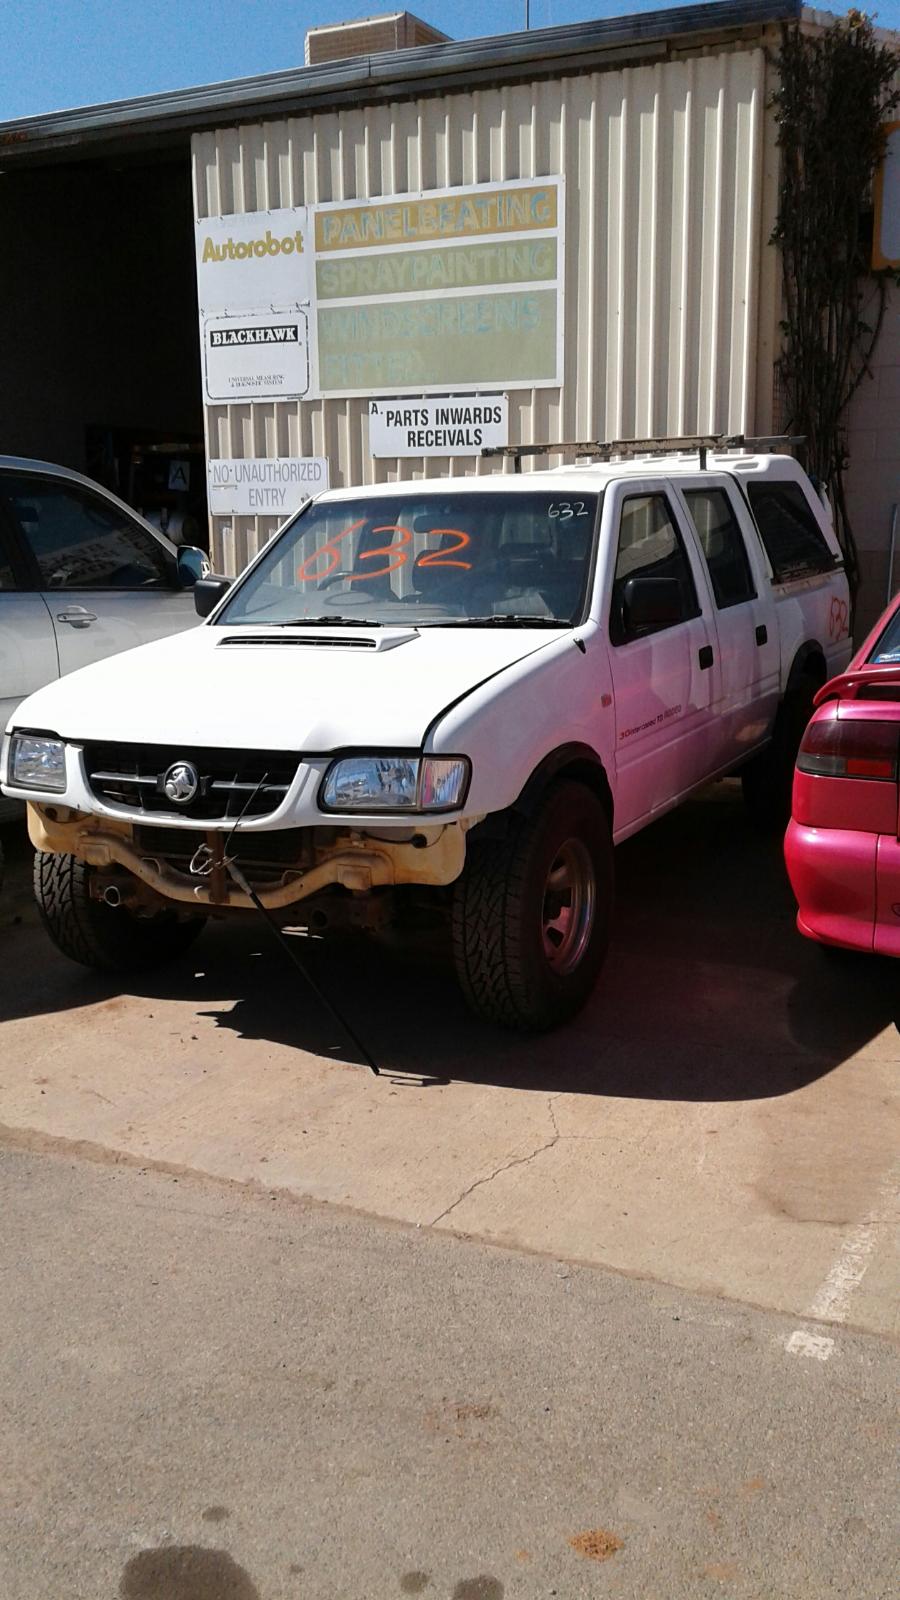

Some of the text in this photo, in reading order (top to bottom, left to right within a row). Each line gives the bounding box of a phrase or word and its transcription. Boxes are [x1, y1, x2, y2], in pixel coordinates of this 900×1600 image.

[322, 190, 551, 245] PANELBEATING
[202, 230, 304, 263] Autorobot
[320, 242, 551, 293] SPRAYPAINTING
[211, 327, 297, 346] BLACKHAWK
[386, 406, 502, 427] PARTS INWARDS
[407, 428, 482, 448] RECEIVALS
[172, 465, 187, 485] A
[213, 462, 322, 483] NO UNAUTHORIZED
[248, 487, 287, 507] ENTRY
[547, 501, 589, 521] 632
[299, 519, 472, 581] 632
